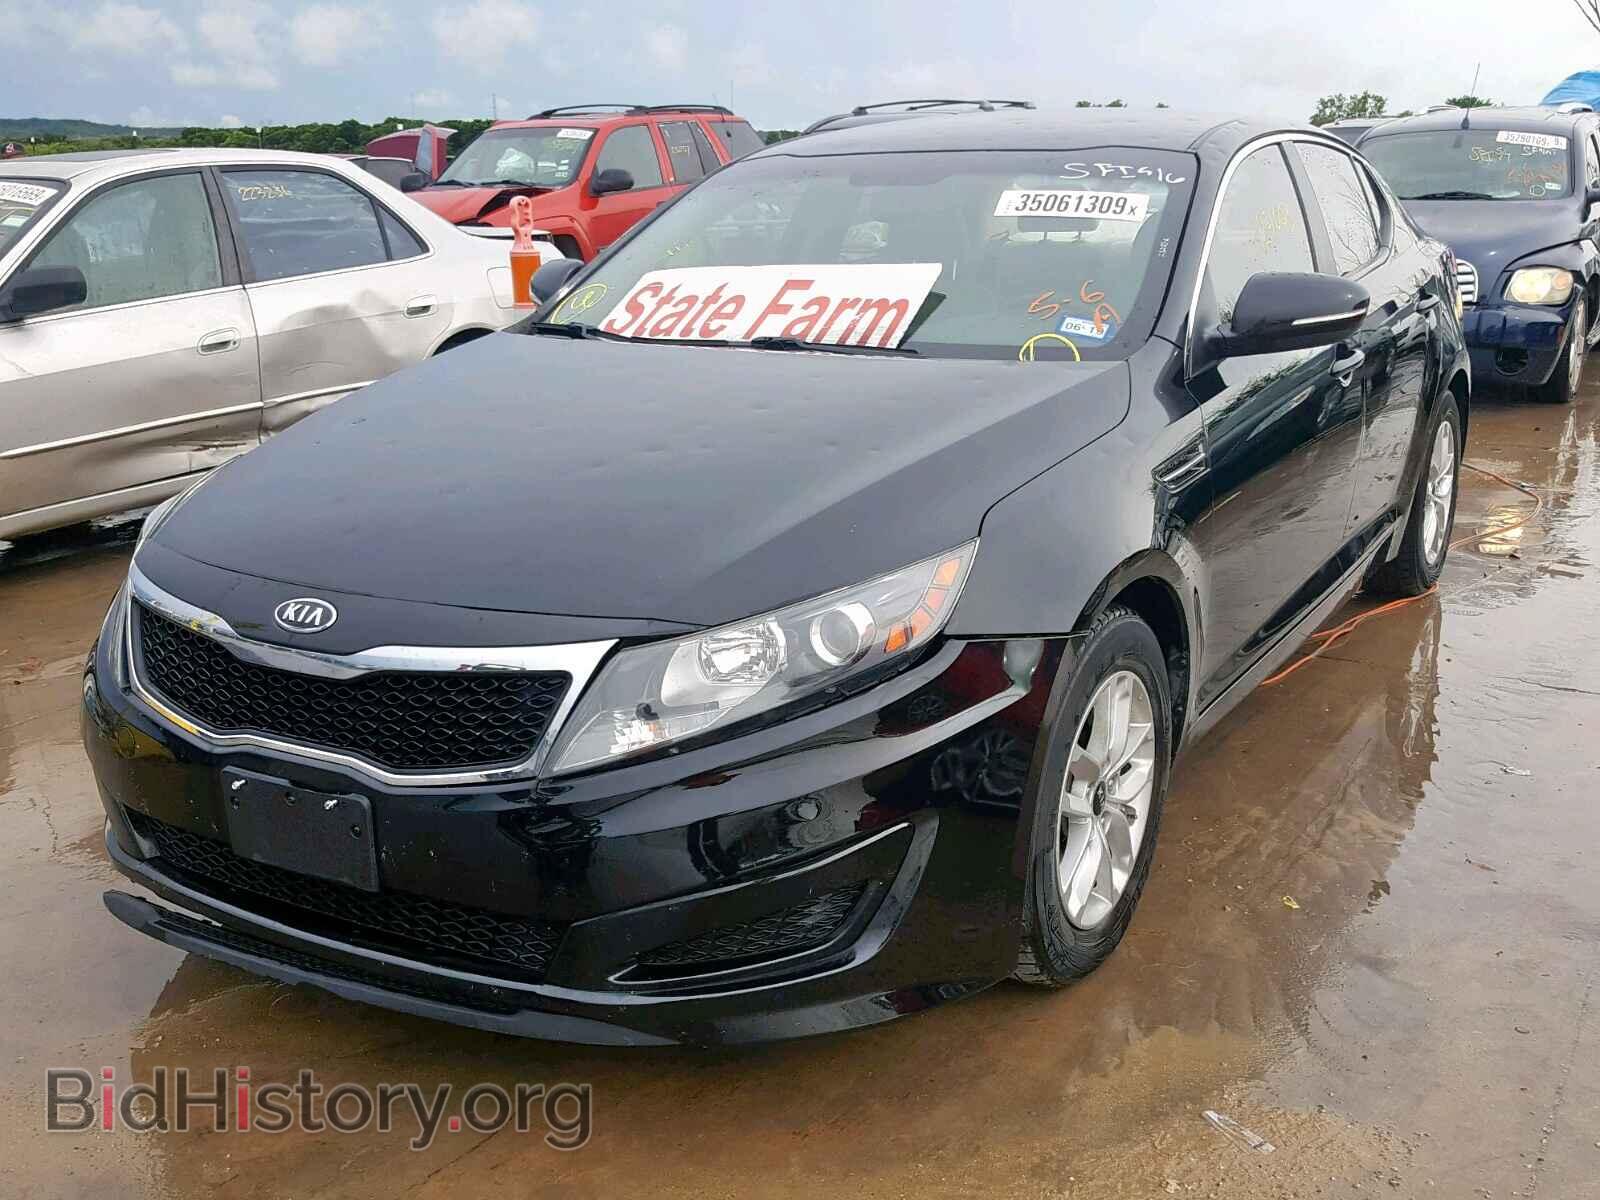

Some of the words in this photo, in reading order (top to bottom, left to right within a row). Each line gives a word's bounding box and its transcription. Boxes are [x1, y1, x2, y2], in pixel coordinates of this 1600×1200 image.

[1014, 193, 1128, 215] 35061309
[603, 281, 746, 340] State
[741, 279, 910, 349] Farm
[281, 602, 324, 626] KIA
